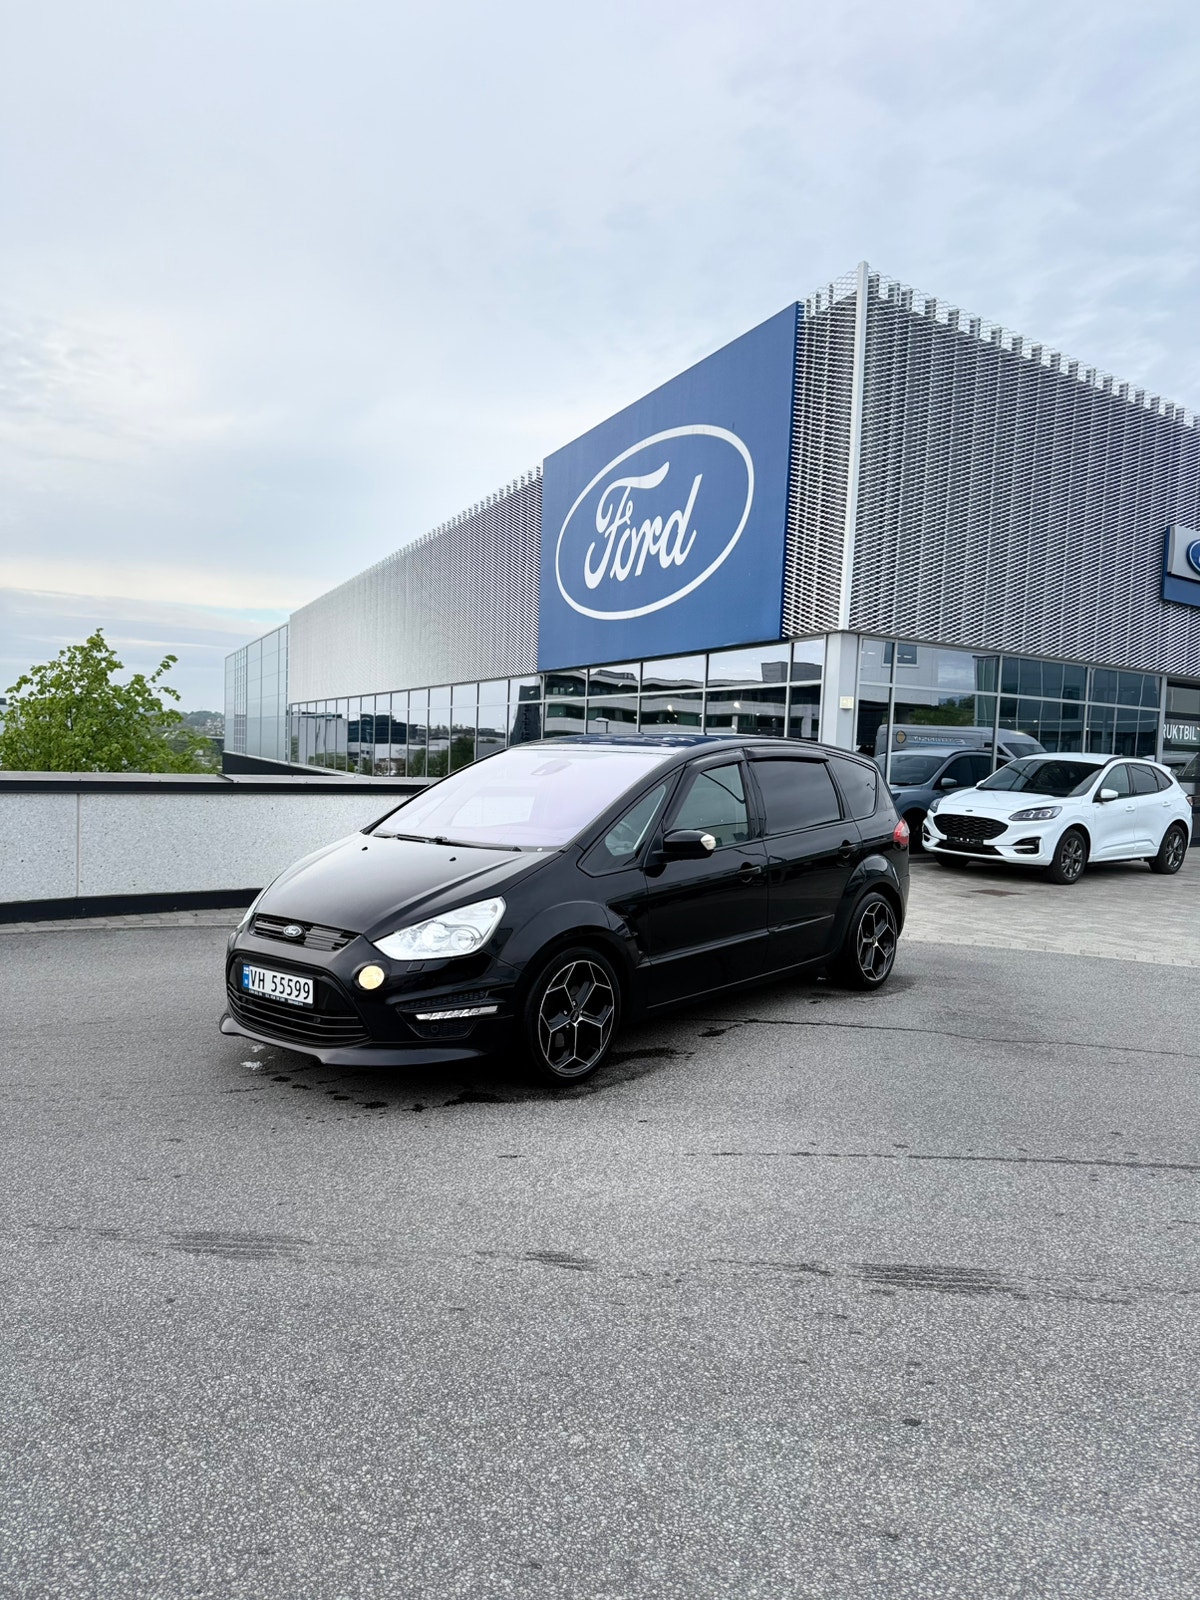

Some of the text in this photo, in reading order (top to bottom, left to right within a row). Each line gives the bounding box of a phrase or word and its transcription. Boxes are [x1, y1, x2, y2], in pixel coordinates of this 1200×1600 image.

[584, 461, 703, 589] Ford
[250, 969, 265, 990] VH
[271, 975, 310, 1000] 55599
